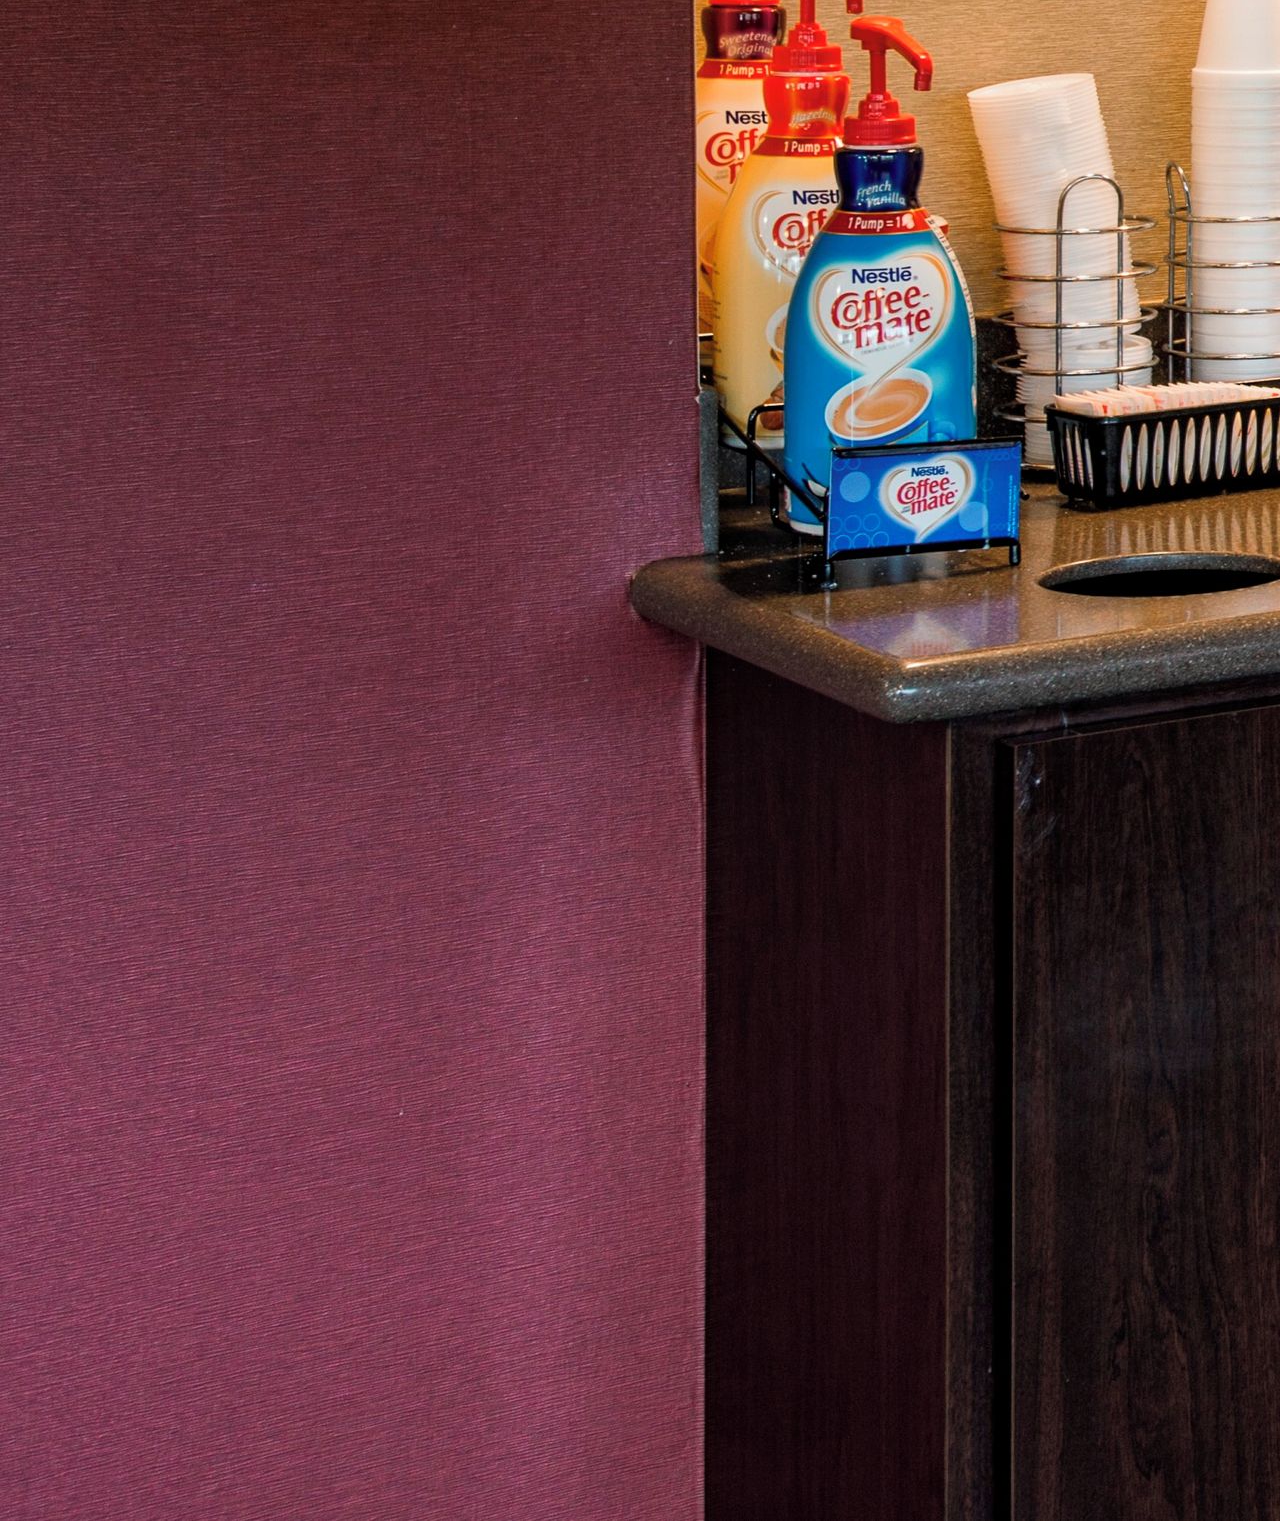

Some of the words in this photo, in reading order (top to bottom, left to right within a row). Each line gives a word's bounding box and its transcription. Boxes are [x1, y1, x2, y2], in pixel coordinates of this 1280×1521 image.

[719, 64, 725, 76] 1
[726, 64, 756, 79] Pump
[726, 110, 769, 125] Nest
[705, 128, 767, 167] Coff
[784, 140, 789, 152] 1
[790, 140, 821, 155] Pump
[792, 190, 840, 205] Nestl
[856, 180, 892, 200] French
[865, 192, 907, 209] Vanilla
[772, 208, 828, 250] Coff
[848, 217, 853, 229] 1
[854, 216, 885, 232] Pump
[853, 308, 932, 349] mate
[910, 490, 956, 515] mate
